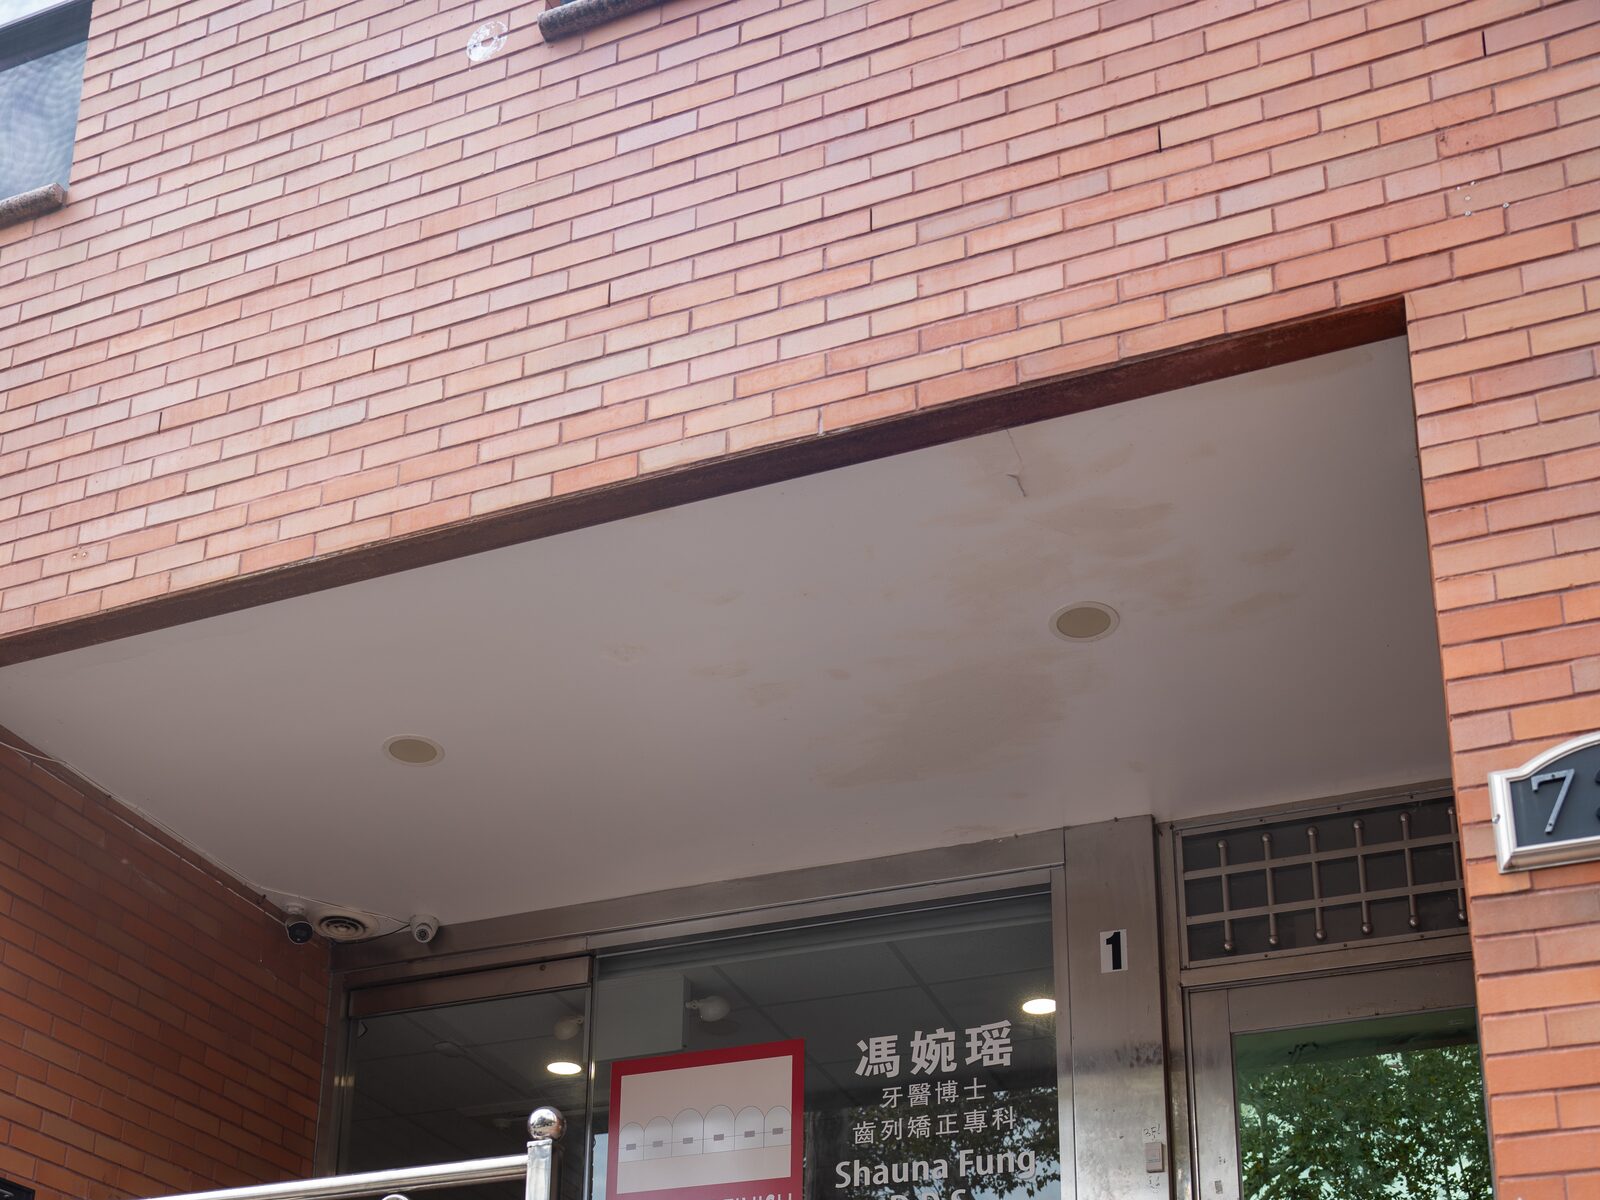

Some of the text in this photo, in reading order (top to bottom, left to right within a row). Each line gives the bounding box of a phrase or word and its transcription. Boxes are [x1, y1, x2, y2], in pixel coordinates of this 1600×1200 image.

[1531, 768, 1600, 833] 7
[1106, 932, 1122, 970] 1
[880, 1077, 987, 1109] 牙醫博士
[852, 1106, 1017, 1145] 齒列矯正專科
[835, 1149, 1036, 1188] Shauna Fung
